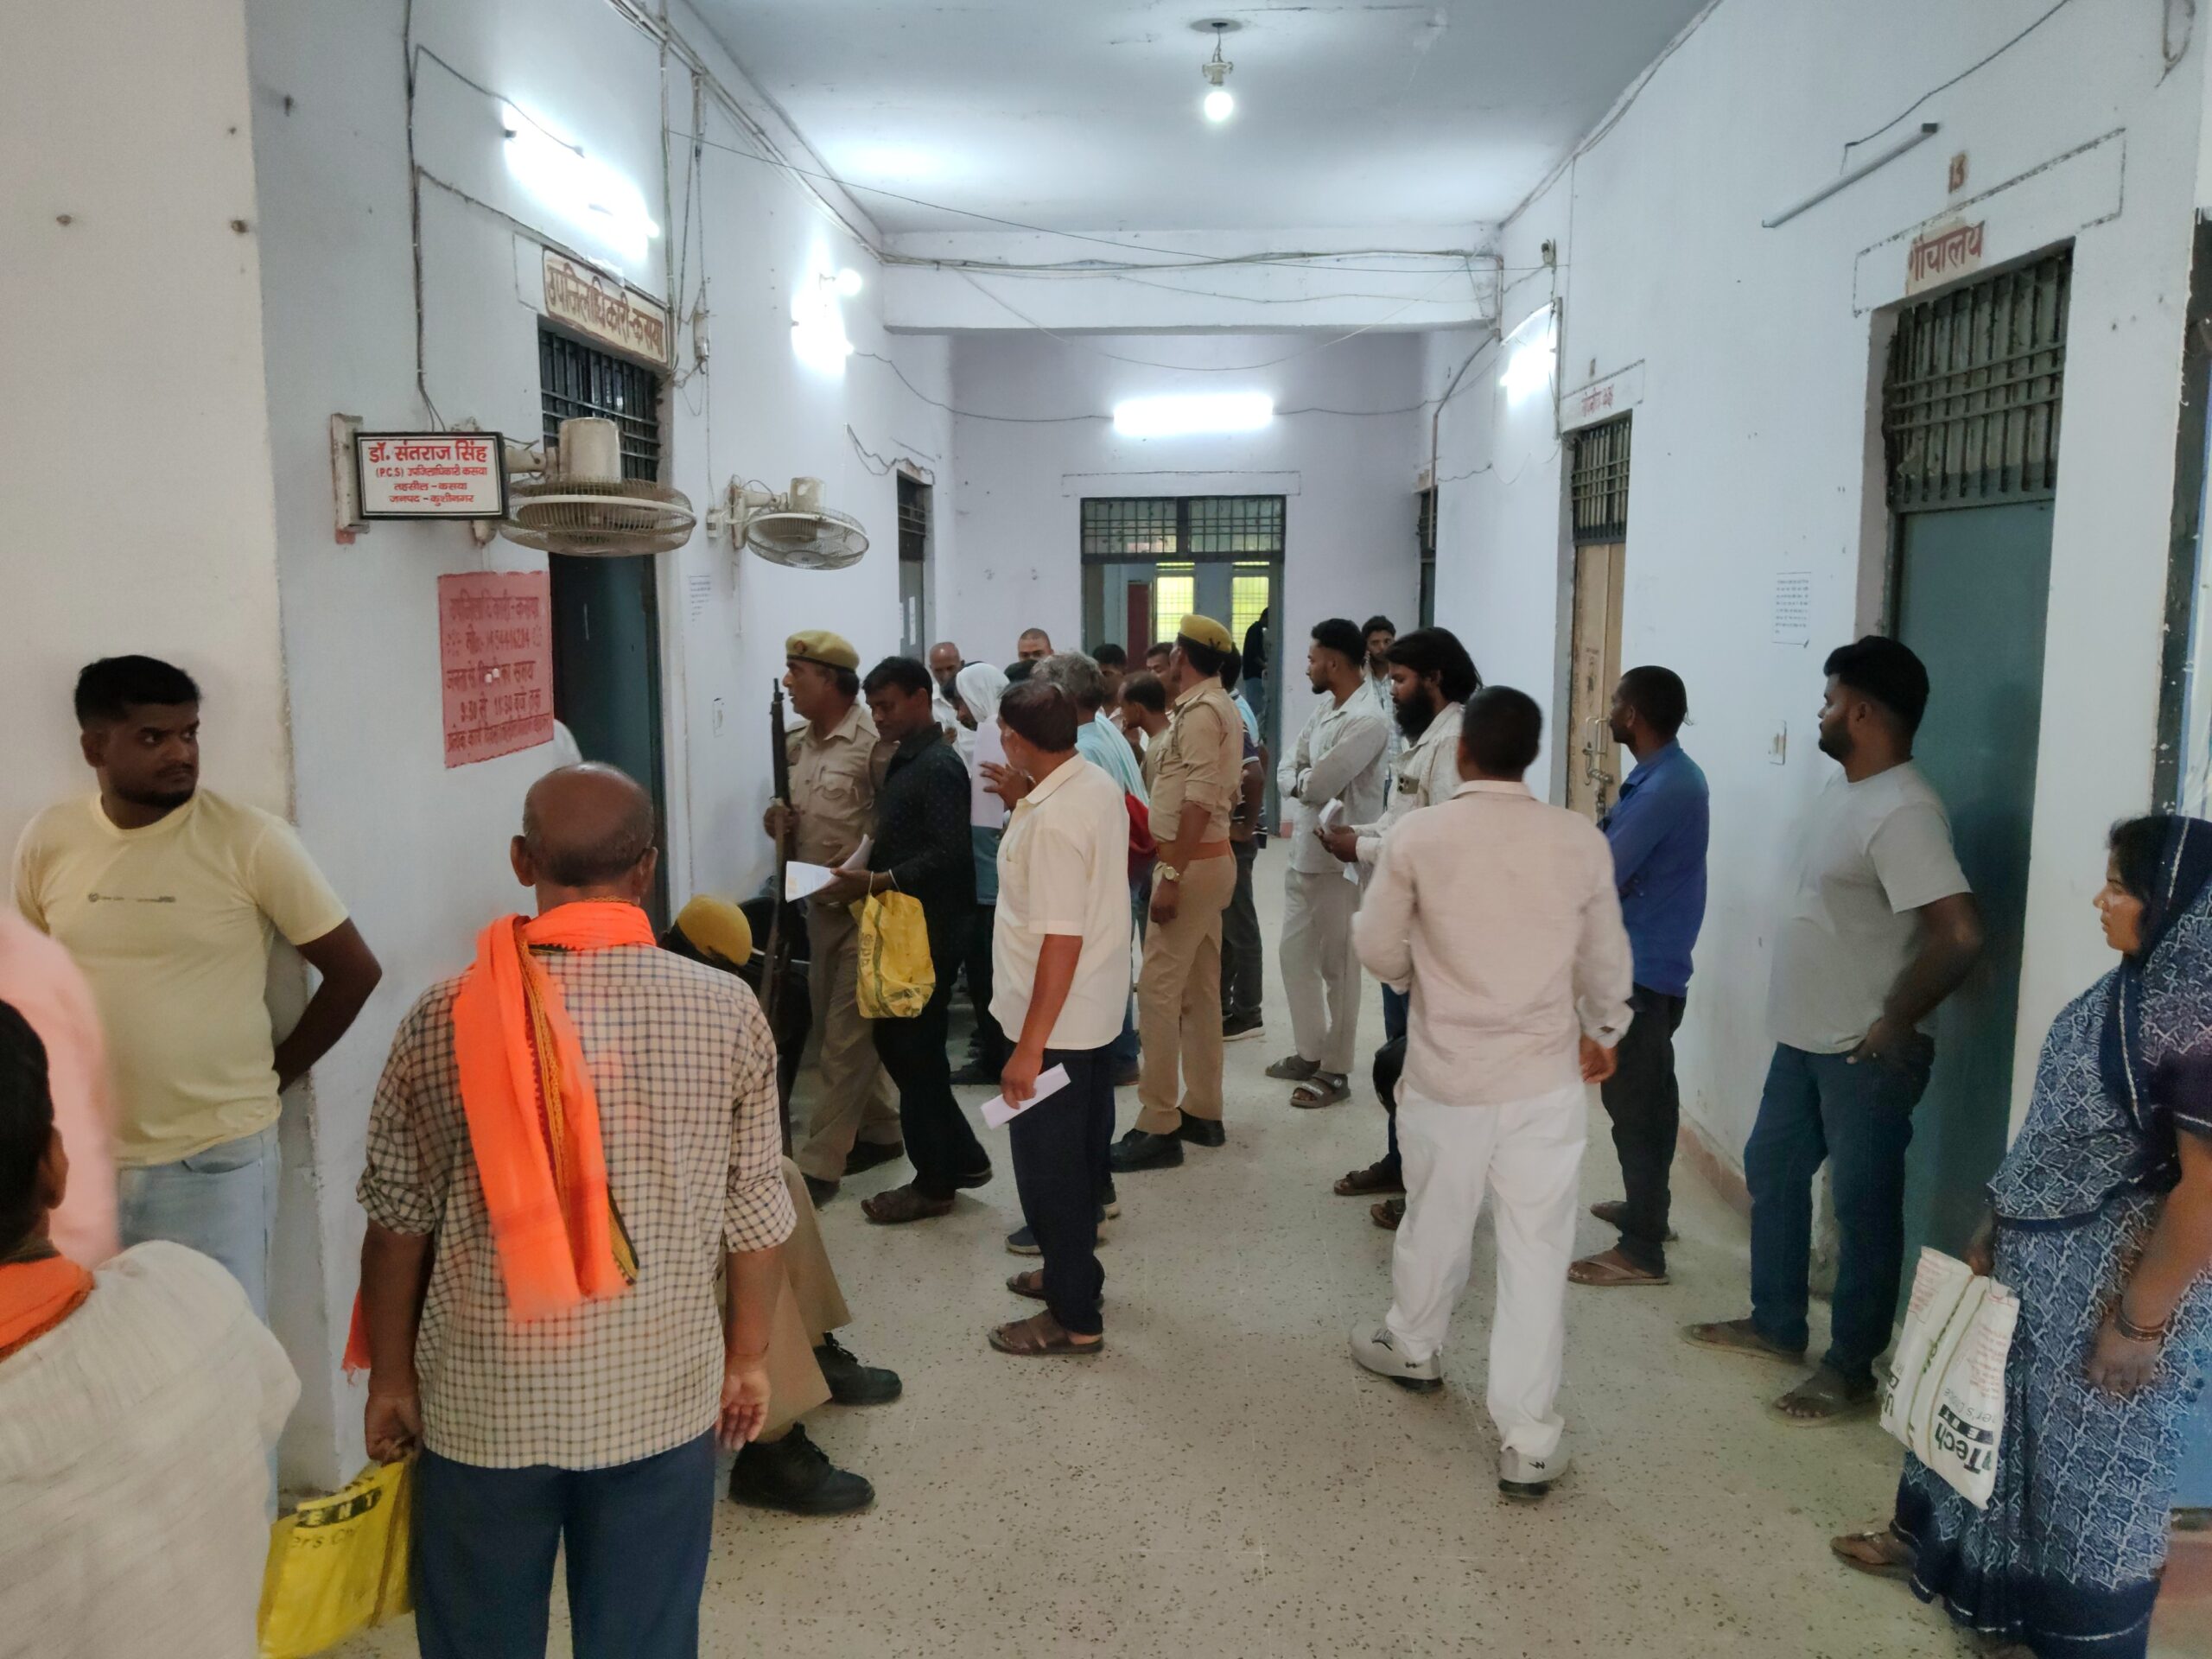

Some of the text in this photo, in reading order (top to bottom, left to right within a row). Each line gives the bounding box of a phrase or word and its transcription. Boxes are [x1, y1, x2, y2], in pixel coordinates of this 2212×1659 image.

[368, 439, 488, 463] डॉ. संतराज सिंह
[394, 480, 429, 491] तहसील
